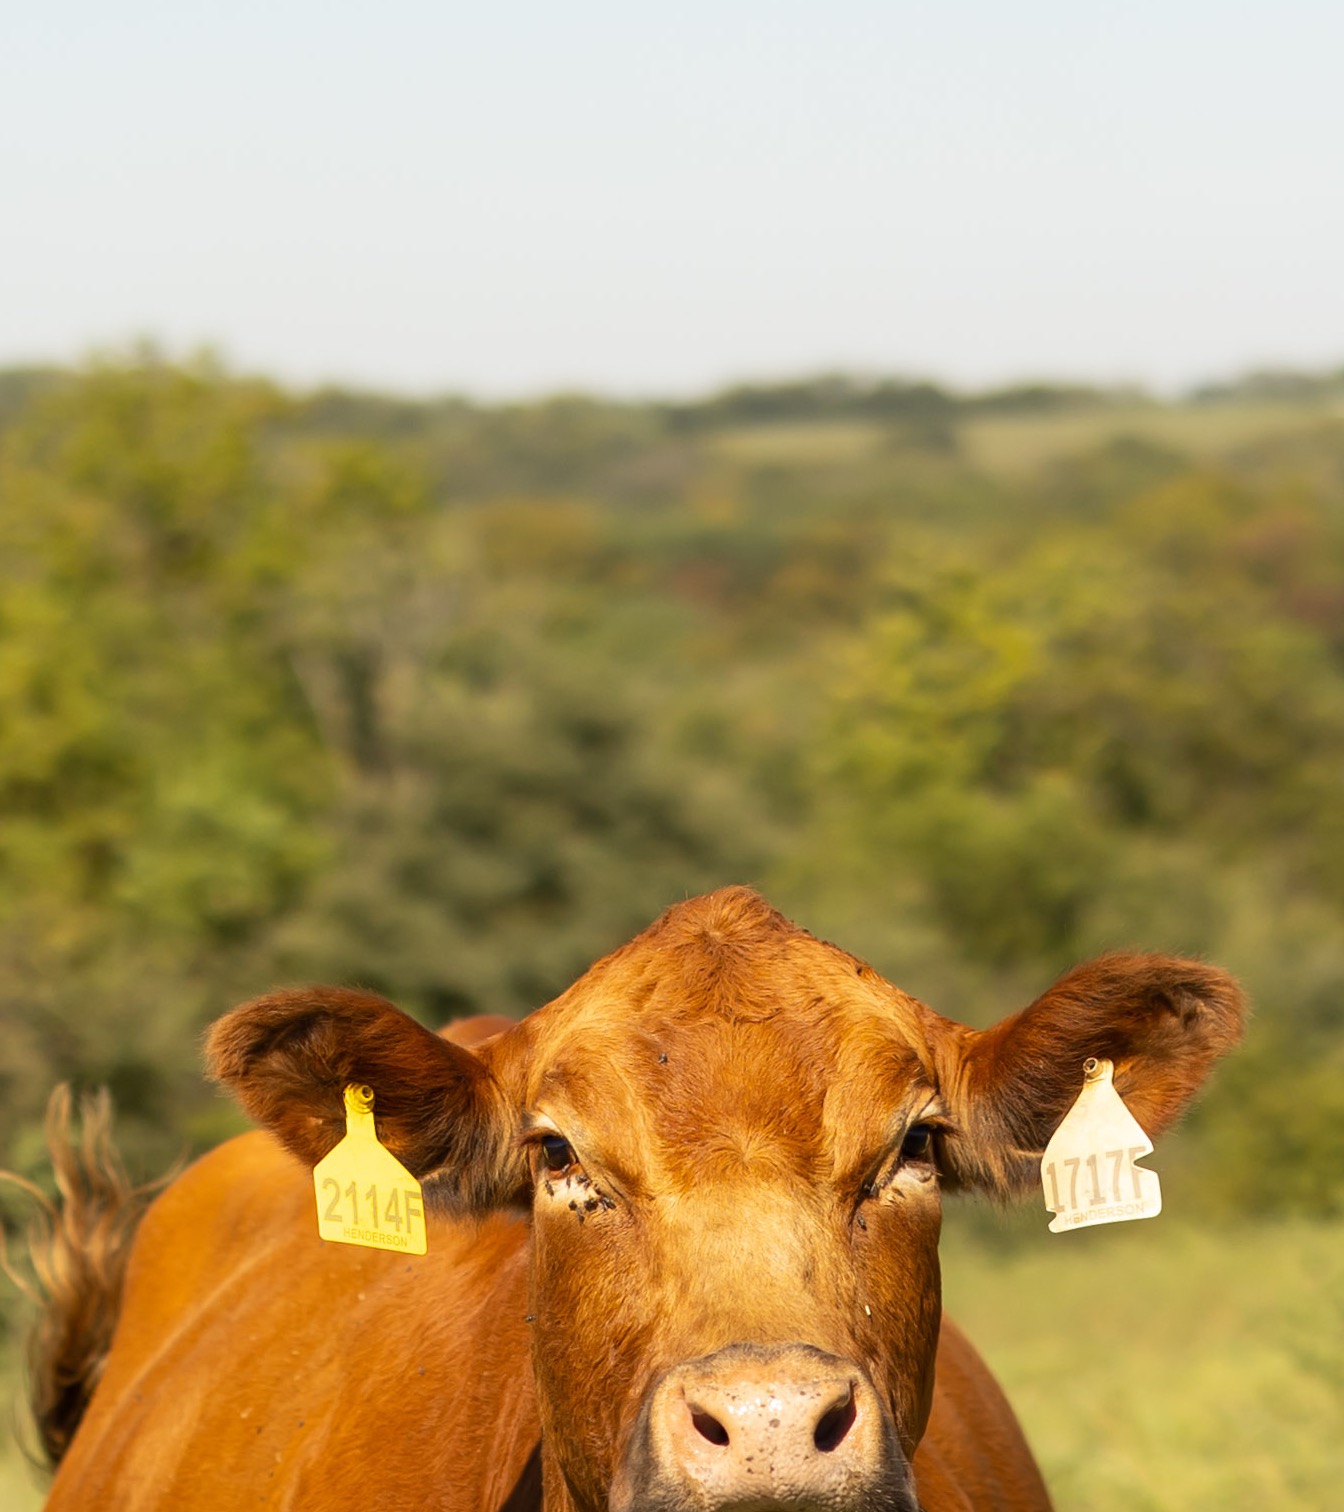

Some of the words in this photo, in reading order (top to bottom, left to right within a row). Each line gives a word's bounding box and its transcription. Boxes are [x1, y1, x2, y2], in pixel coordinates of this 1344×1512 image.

[1046, 1146, 1147, 1213] 1717F
[321, 1177, 422, 1234] 2114F
[1064, 1202, 1145, 1225] HENDERSON
[343, 1227, 408, 1247] HENDERSON
